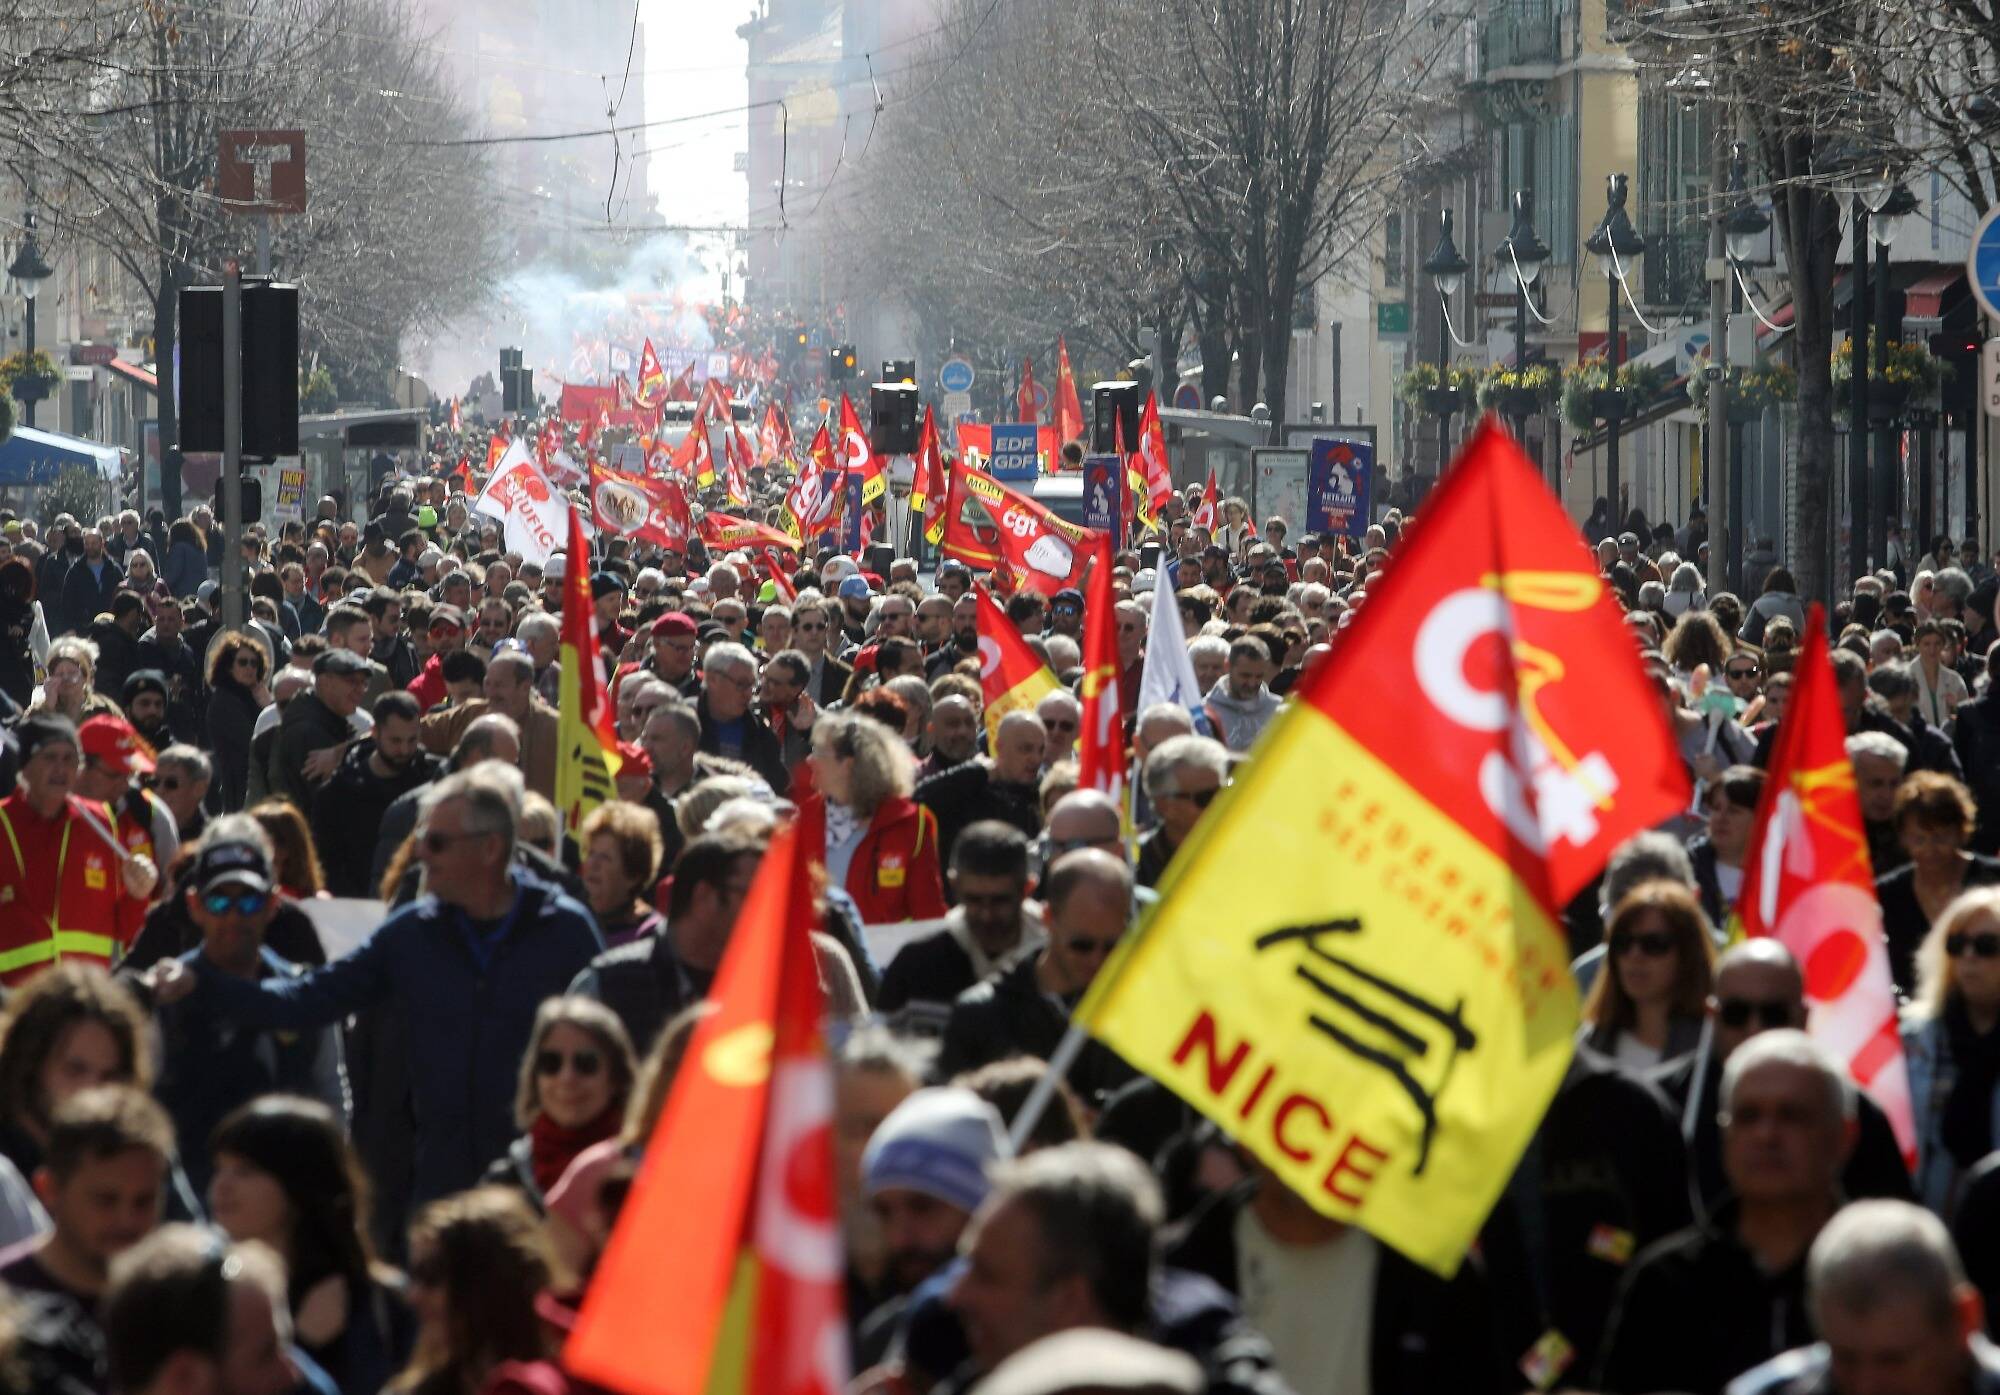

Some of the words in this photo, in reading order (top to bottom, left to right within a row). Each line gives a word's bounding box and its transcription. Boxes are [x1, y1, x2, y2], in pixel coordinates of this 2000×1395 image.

[235, 144, 291, 200] T
[996, 437, 1034, 452] EDF
[994, 454, 1035, 470] GDF
[968, 477, 1003, 497] MORT
[1003, 510, 1038, 538] cgt
[1171, 1010, 1391, 1208] NICE
